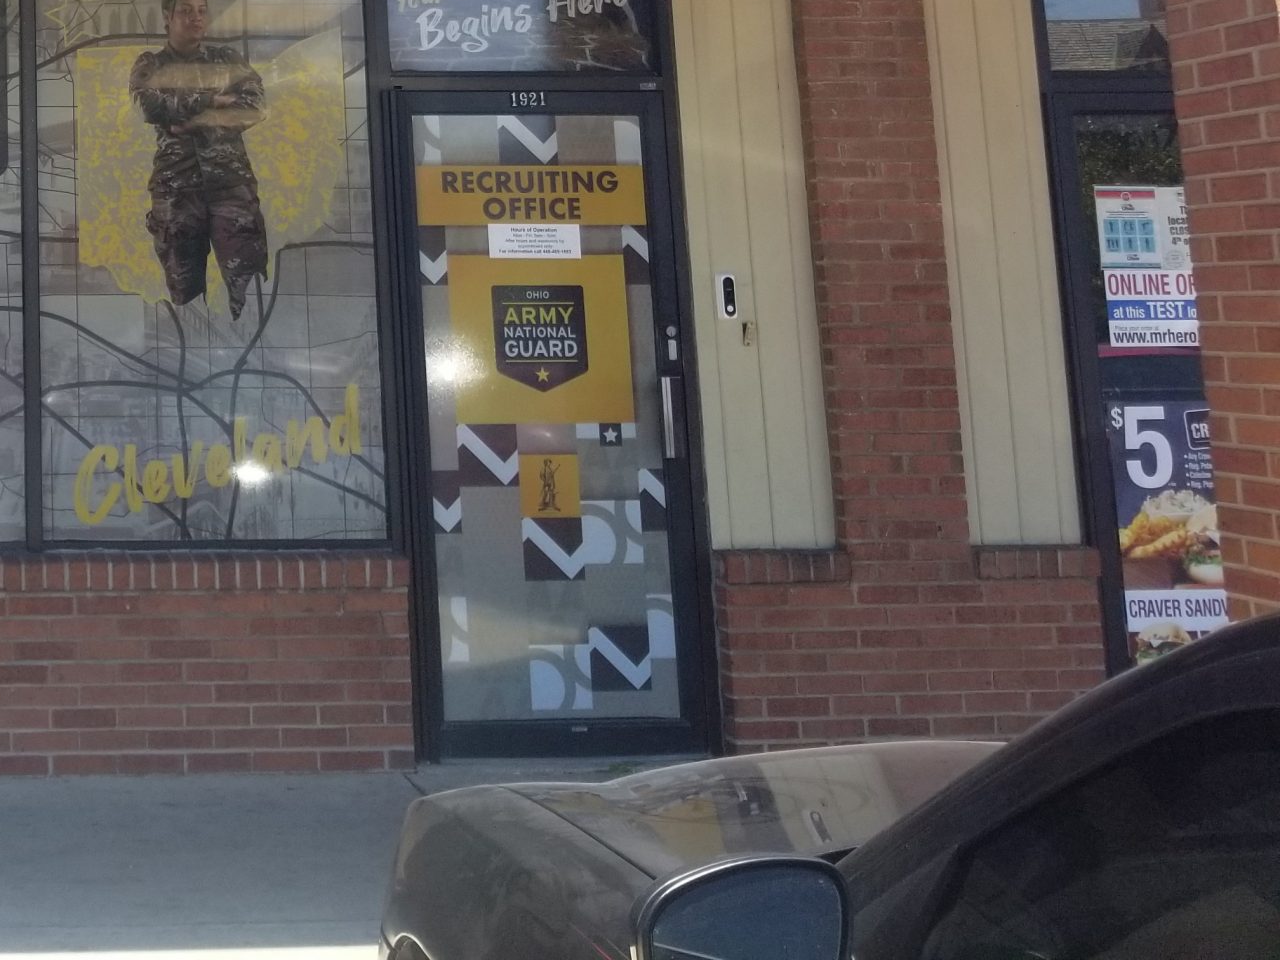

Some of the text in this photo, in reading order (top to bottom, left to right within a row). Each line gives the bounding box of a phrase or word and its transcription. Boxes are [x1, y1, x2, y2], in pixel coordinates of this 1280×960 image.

[415, 3, 533, 53] Begins
[509, 90, 548, 108] 1921
[441, 171, 619, 194] RECRUITING
[482, 197, 582, 220] OFFICE
[1108, 273, 1171, 296] ONLINE
[526, 290, 550, 300] OHIO
[504, 306, 574, 325] ARMY
[1113, 306, 1124, 319] at
[1127, 306, 1146, 319] this
[1146, 301, 1185, 319] TEST
[504, 326, 577, 338] NATIONAL
[504, 340, 578, 358] GUARD
[73, 383, 363, 525] Cleveland
[1129, 598, 1182, 619] CRAVER
